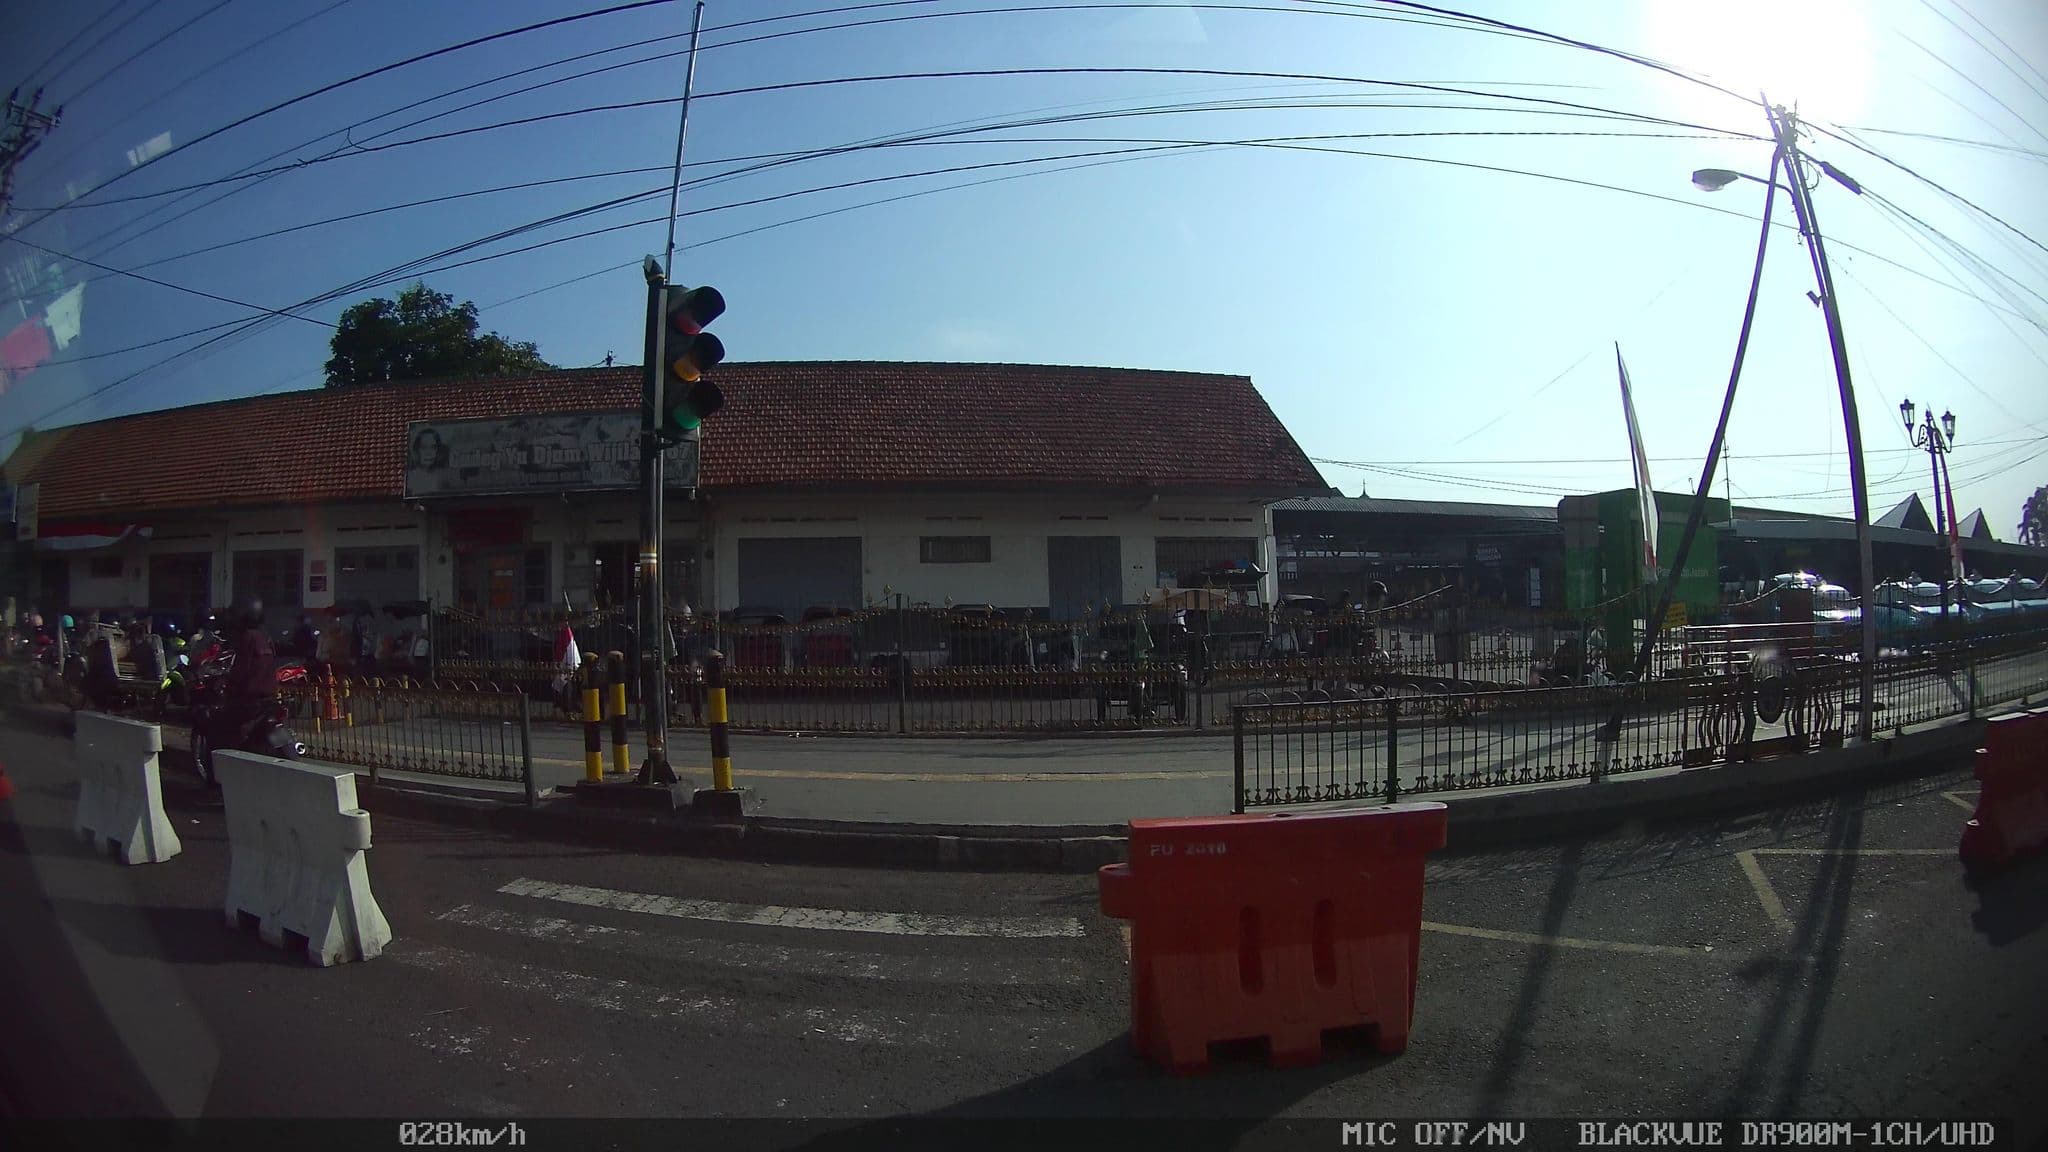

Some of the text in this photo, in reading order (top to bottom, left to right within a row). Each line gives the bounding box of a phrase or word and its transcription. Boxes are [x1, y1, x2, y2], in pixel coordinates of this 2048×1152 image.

[505, 445, 528, 465] Yu
[533, 445, 582, 469] Djum
[587, 440, 642, 467] Wijila
